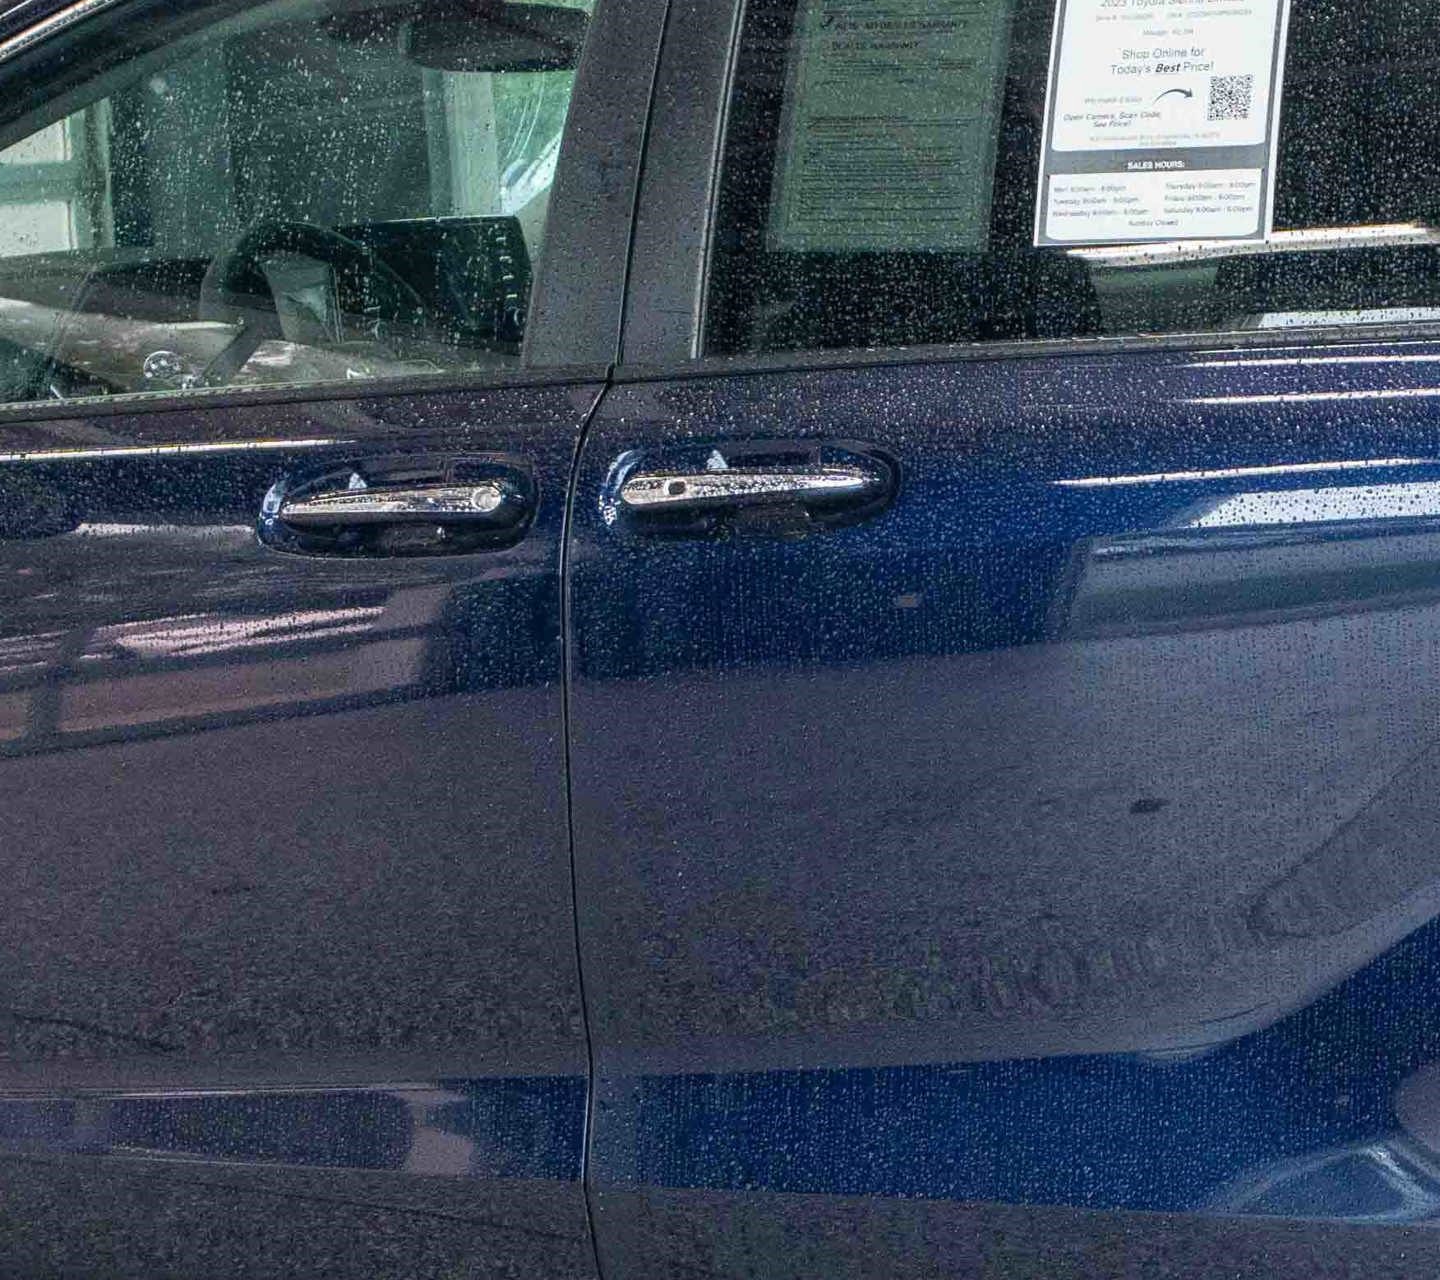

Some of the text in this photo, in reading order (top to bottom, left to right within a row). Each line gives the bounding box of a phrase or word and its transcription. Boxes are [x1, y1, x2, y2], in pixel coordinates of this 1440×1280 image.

[1121, 46, 1205, 61] Shop Online for
[1111, 61, 1215, 75] Today's Best Price!
